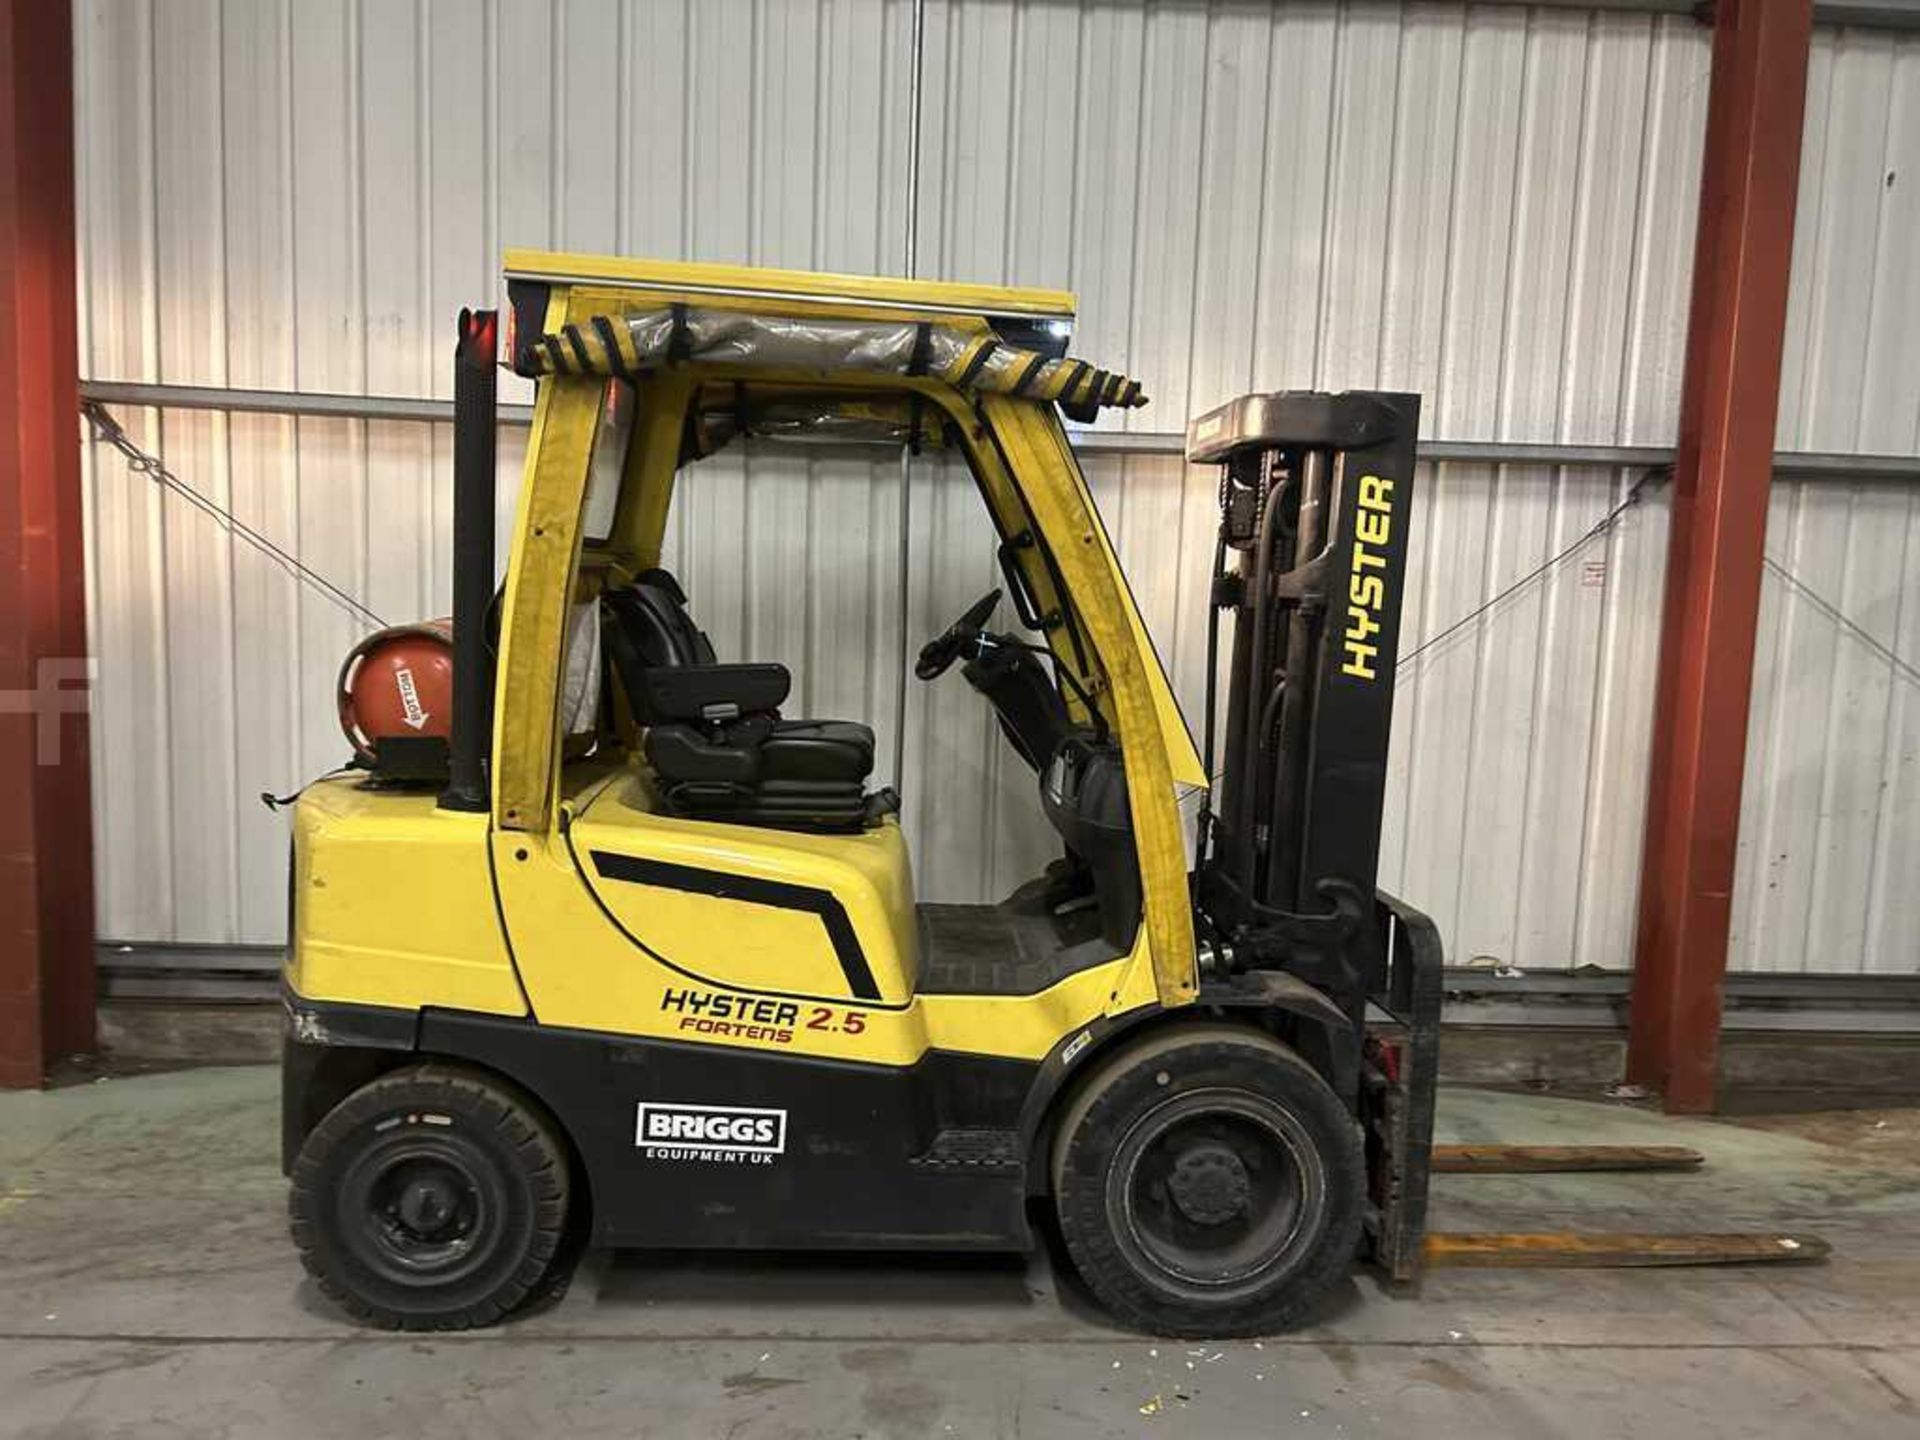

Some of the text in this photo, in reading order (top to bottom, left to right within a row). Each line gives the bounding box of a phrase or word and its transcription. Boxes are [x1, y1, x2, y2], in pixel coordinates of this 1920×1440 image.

[1342, 475, 1394, 680] HYSTER
[399, 673, 421, 720] BOTTOM
[660, 988, 867, 1034] HYSTER 2.5
[648, 1113, 774, 1142] BRIGGS
[646, 1148, 773, 1164] EQUIPMENT UK
